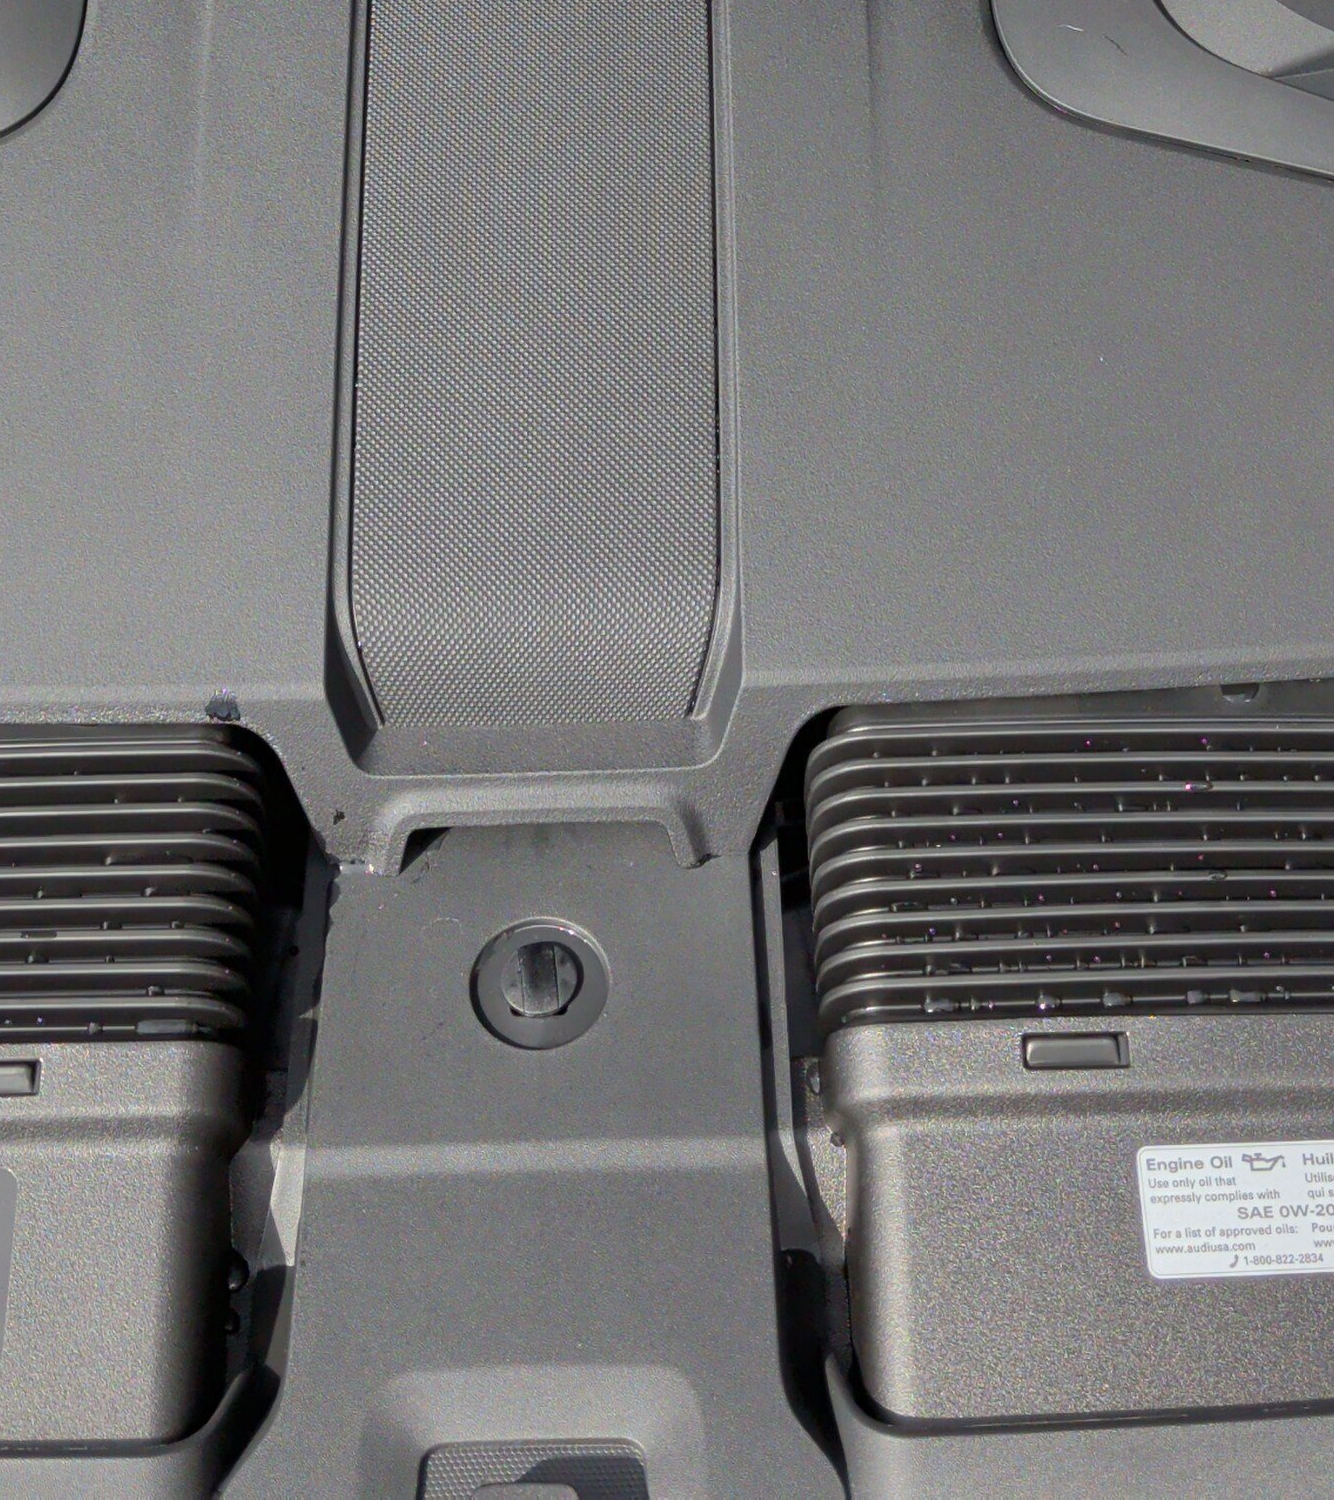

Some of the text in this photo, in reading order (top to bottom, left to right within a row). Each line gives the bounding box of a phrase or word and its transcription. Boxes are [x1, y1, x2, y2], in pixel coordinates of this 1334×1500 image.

[1145, 1156, 1232, 1173] Engine Oil
[1148, 1176, 1236, 1189] Use only oil that
[1150, 1188, 1280, 1205] expressly complies with
[1307, 1188, 1325, 1199] qui
[1237, 1206, 1274, 1220] SAE
[1154, 1223, 1298, 1239] For a list of approved oils:
[1155, 1242, 1256, 1254] www.audiusa.com
[1244, 1253, 1324, 1266] 1-800-822-2834
